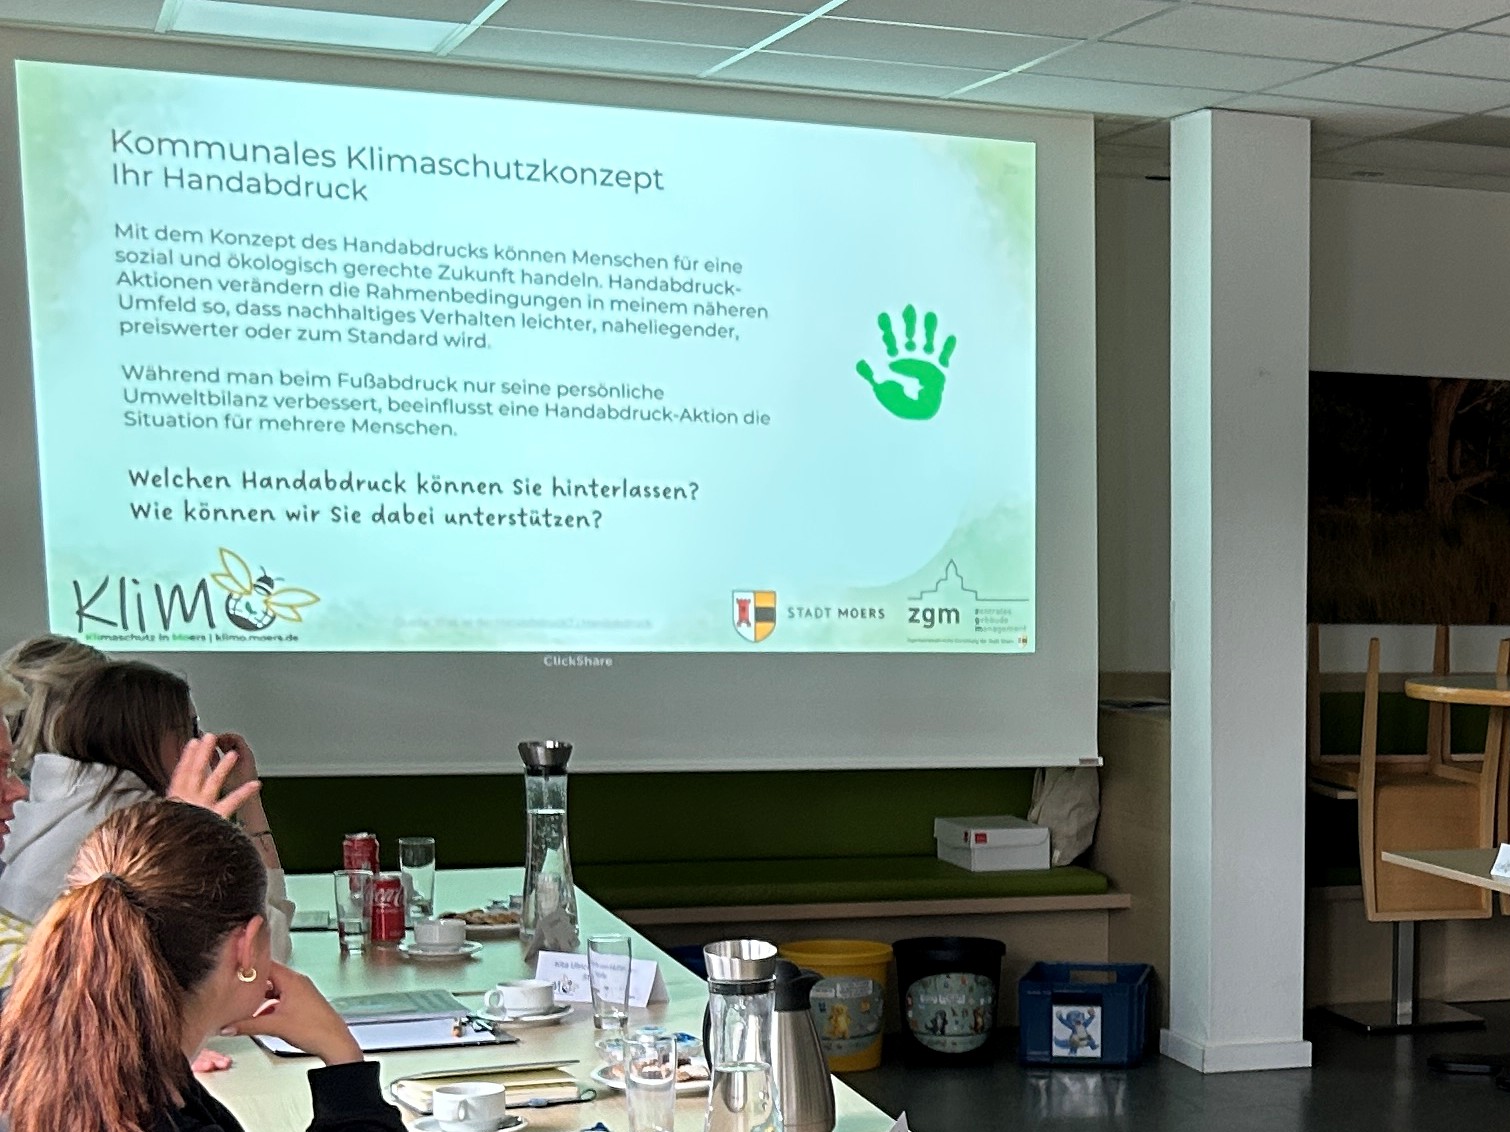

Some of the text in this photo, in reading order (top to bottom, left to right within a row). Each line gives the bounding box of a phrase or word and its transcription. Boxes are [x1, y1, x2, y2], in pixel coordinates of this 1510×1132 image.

[111, 128, 665, 194] Kommunales Klimaschutzkonzept
[112, 162, 368, 202] Ihr Handabdruck
[114, 222, 743, 275] Mit dem Konzept des Handabdrucks können Menschen für eine
[114, 247, 742, 296] sozial und ökologisch gerechte Zukunft handeln. Handabdruck-
[115, 269, 769, 319] Aktionen verändern die Rahmenbedingungen in meinem näheren
[118, 293, 740, 342] Umfeld so, dass nachhaltiges Verhalten leichter, naheliegender,
[119, 317, 492, 350] preiswerter oder zum Standard wird.
[120, 364, 665, 401] Während man beim Fußabdruck nur seine persönliche
[123, 387, 771, 426] Umweltbilanz verbessert, beeinflusst eine Handabdruck-Aktion die
[123, 409, 458, 437] Situation für mehrere Menschen.
[127, 465, 700, 501] Welchen Handabdruck können Sie hinterlassen?
[129, 498, 603, 530] Wie können wir Sie dabei unterstützen?
[787, 606, 886, 620] STADT MOERS
[907, 607, 960, 629] zgm
[86, 633, 155, 642] Klimaschutz
[159, 633, 169, 642] in
[543, 655, 613, 667] ClickShare
